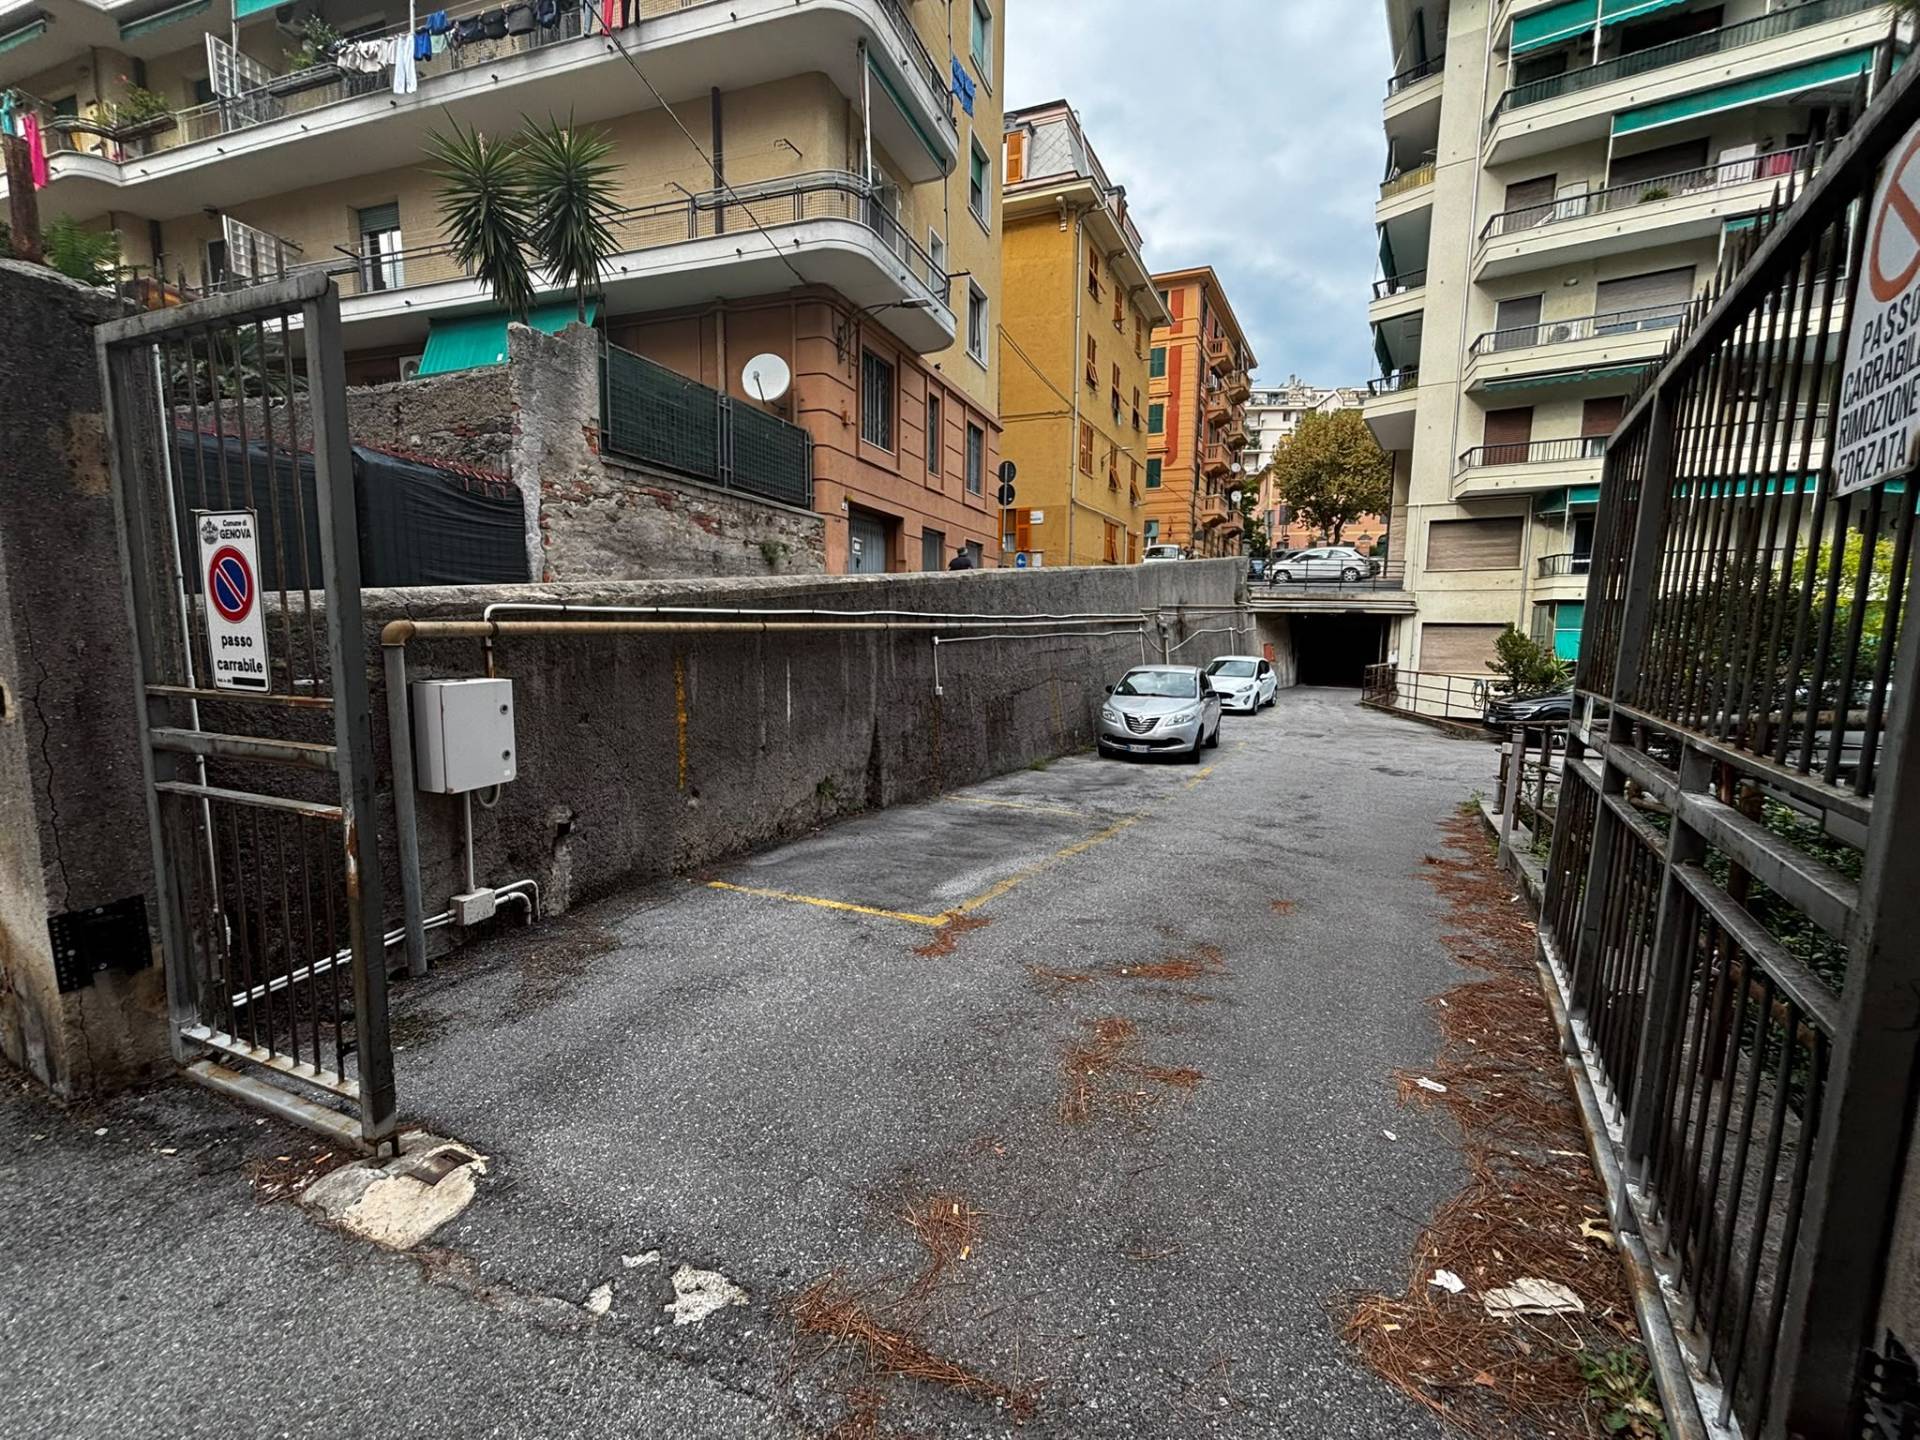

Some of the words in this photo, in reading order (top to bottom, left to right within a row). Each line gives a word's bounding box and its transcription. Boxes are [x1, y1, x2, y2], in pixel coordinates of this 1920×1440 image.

[1861, 284, 1920, 360] PASSO
[1843, 331, 1920, 409] CARRABIL
[1838, 373, 1920, 450] RIMOZIONE
[1837, 426, 1907, 491] FORZATA
[219, 528, 252, 540] GENOVA
[217, 658, 263, 673] carrabile
[221, 635, 253, 649] passo
